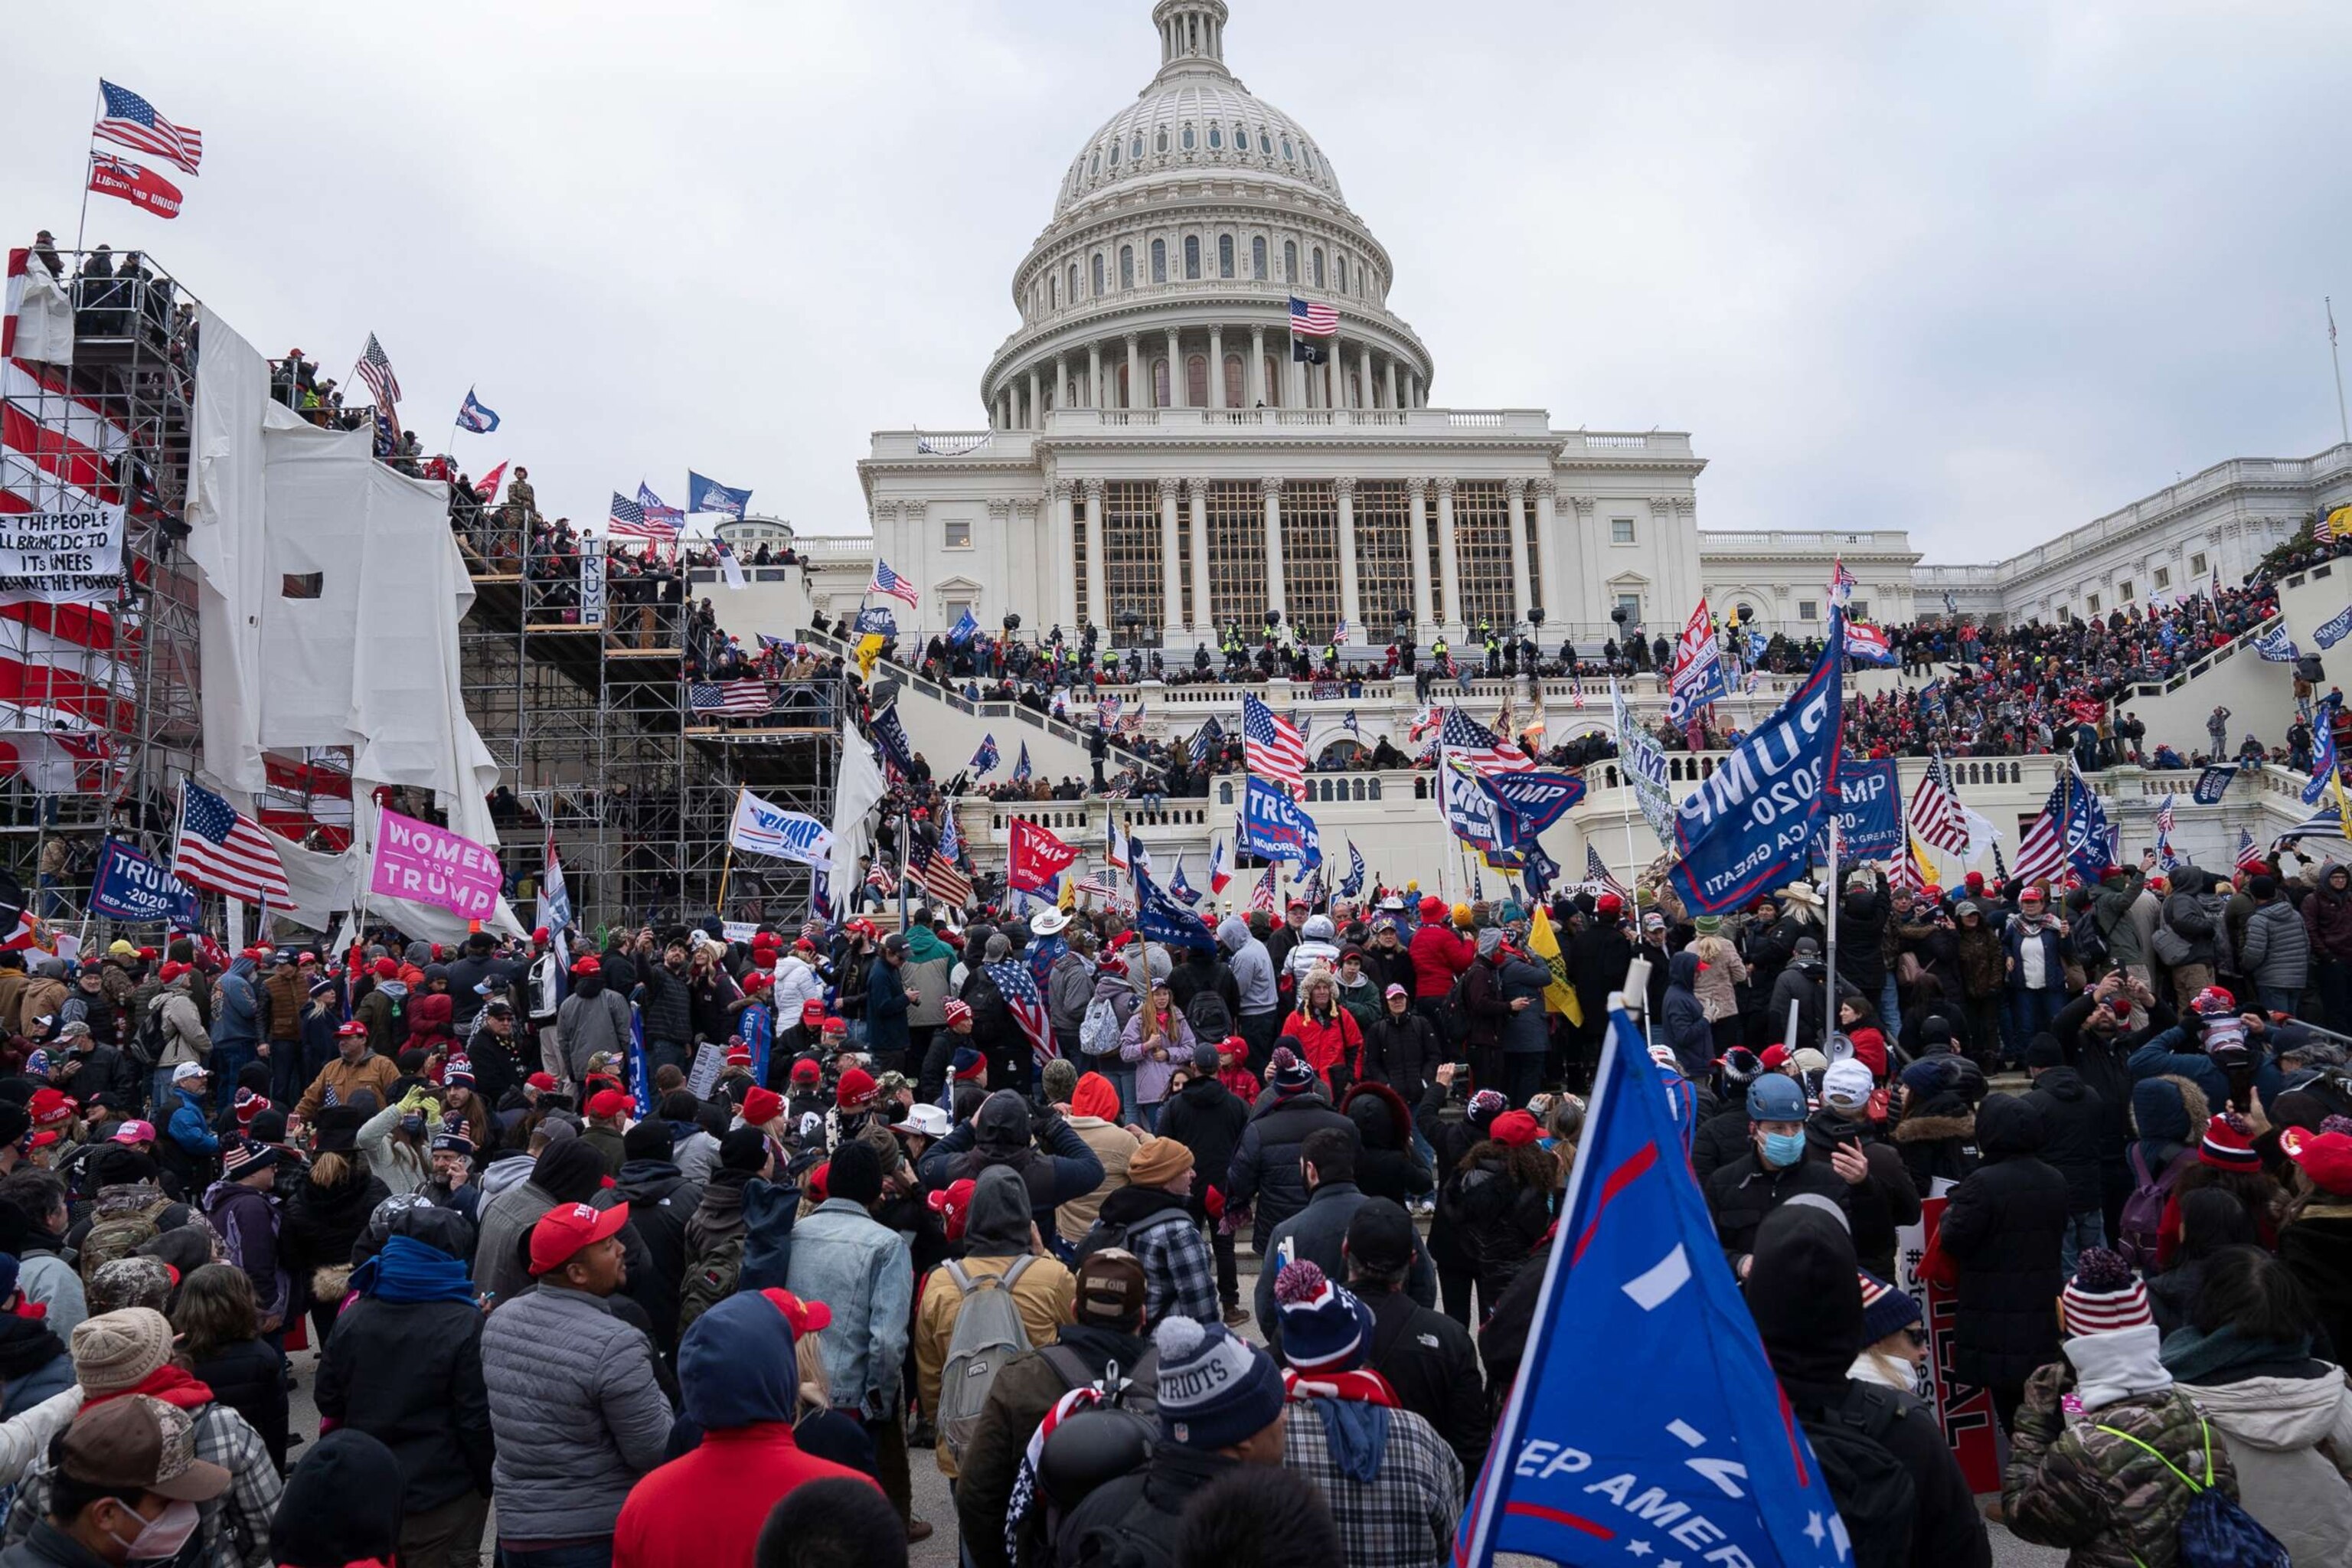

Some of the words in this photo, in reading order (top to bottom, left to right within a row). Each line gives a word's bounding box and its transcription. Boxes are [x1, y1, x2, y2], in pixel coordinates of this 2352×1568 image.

[60, 534, 83, 550] DC
[87, 531, 108, 548] TO
[583, 540, 599, 625] TRUMP
[1859, 831, 1896, 843] GREAT!
[389, 820, 499, 878] WOMEN
[423, 858, 455, 877] FOR
[384, 862, 490, 912] TRUMP
[1564, 884, 1597, 894] Biden
